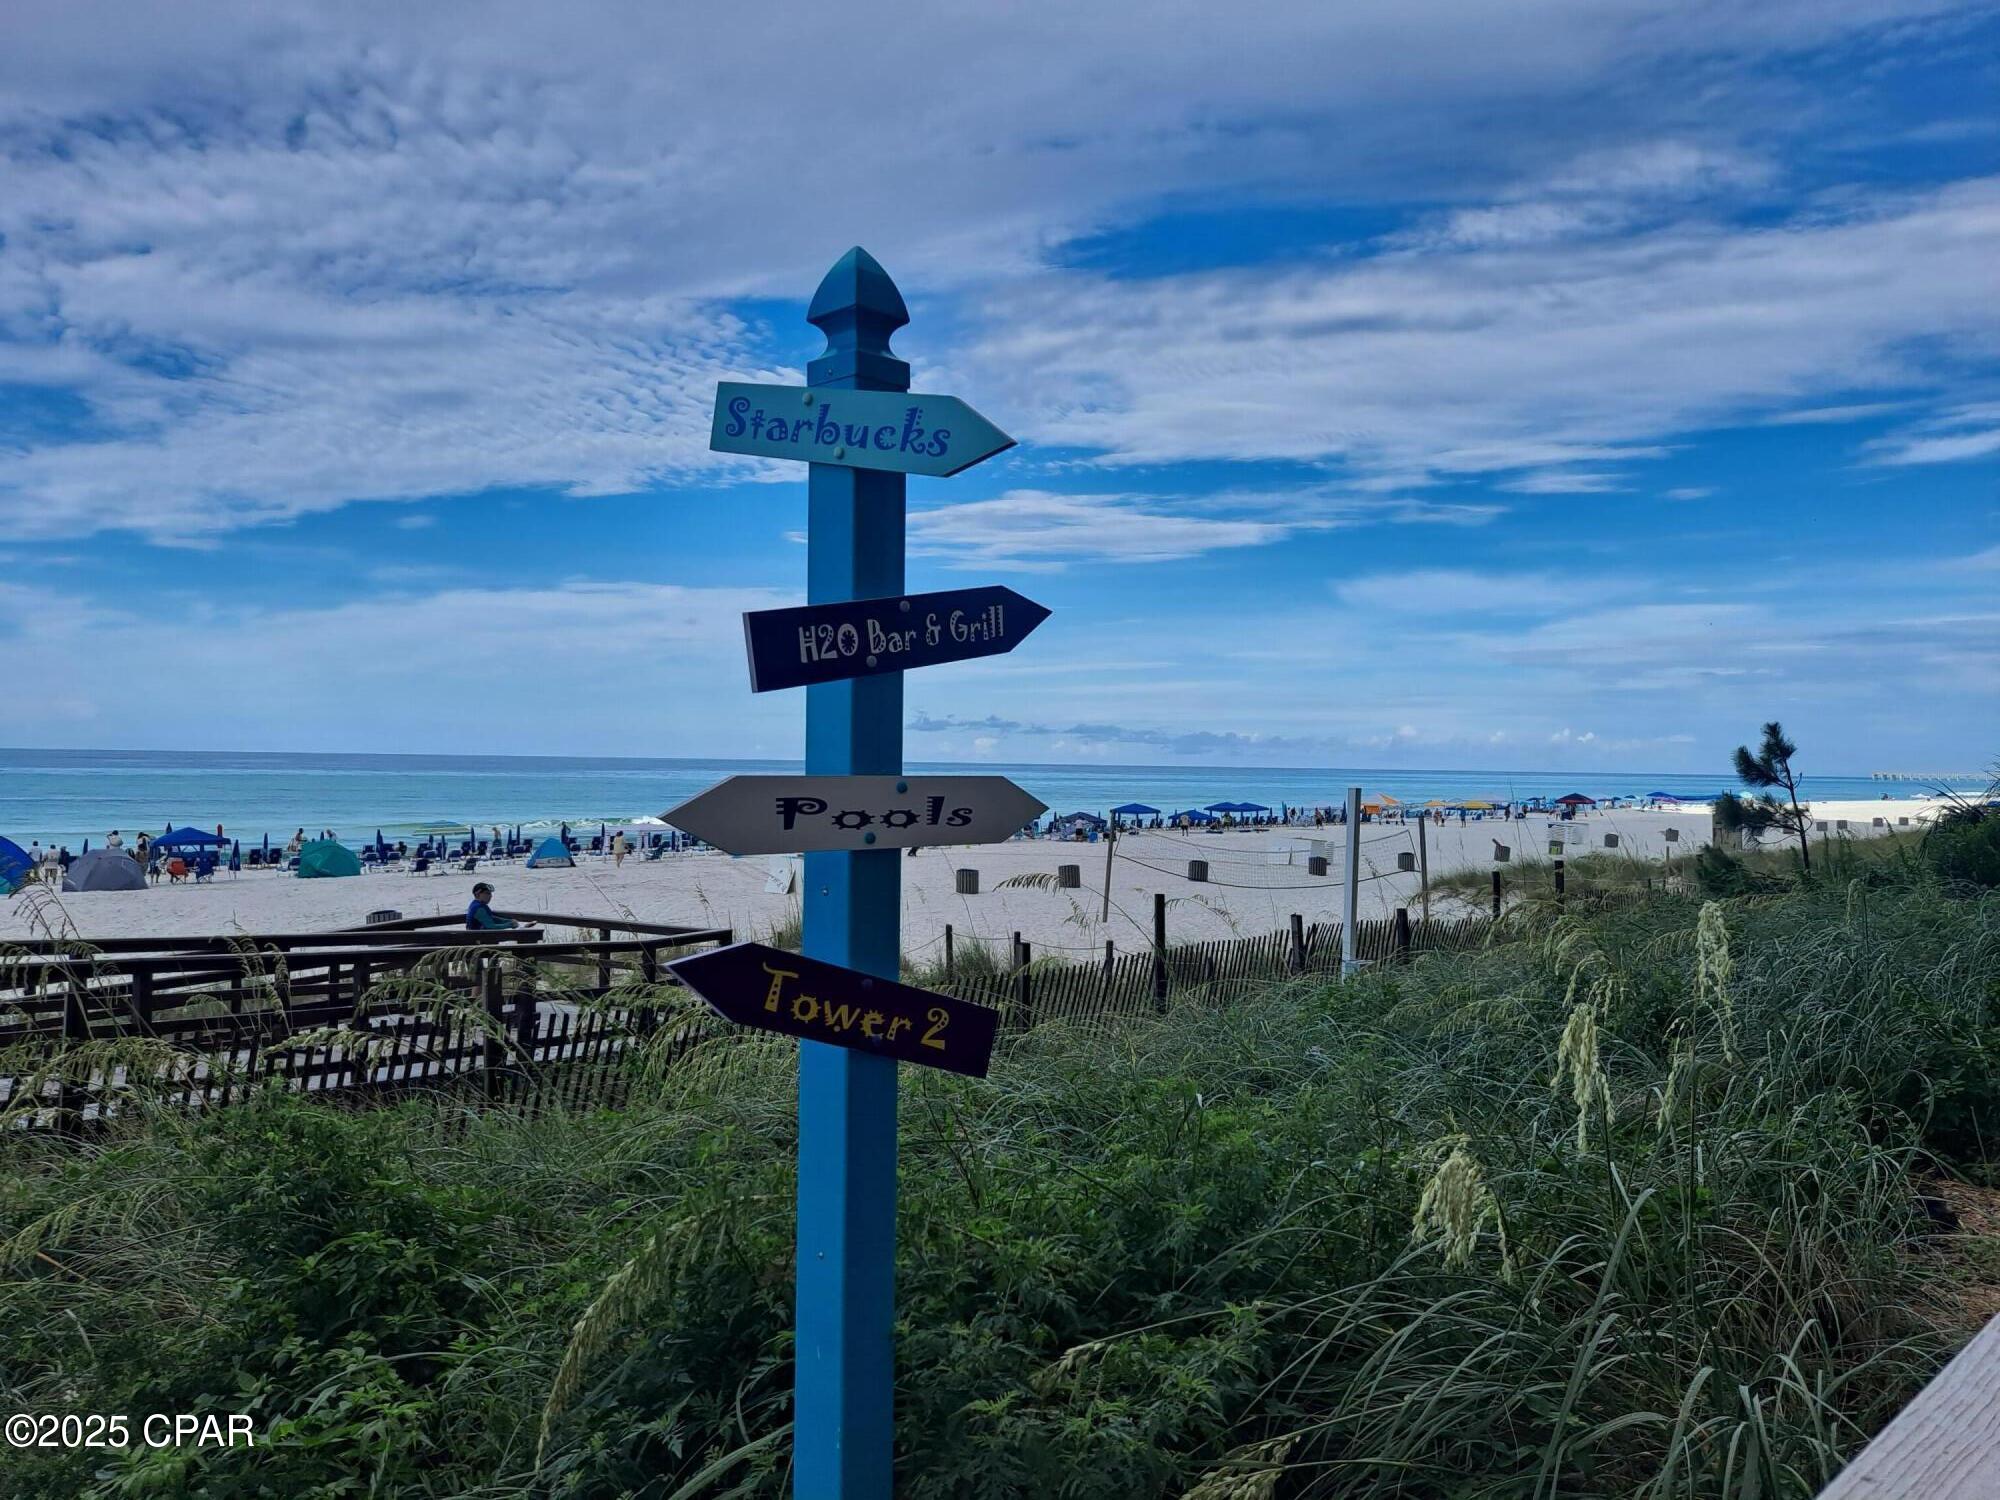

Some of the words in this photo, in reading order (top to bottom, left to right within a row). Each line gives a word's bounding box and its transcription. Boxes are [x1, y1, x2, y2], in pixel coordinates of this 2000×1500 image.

[726, 396, 951, 457] Starbucks
[799, 623, 859, 663] H2O
[867, 618, 916, 655] Bar
[926, 613, 941, 646] &
[949, 604, 1004, 642] Grill
[775, 795, 973, 830] Pools
[763, 962, 912, 1040] Tower
[920, 1008, 950, 1050] 2
